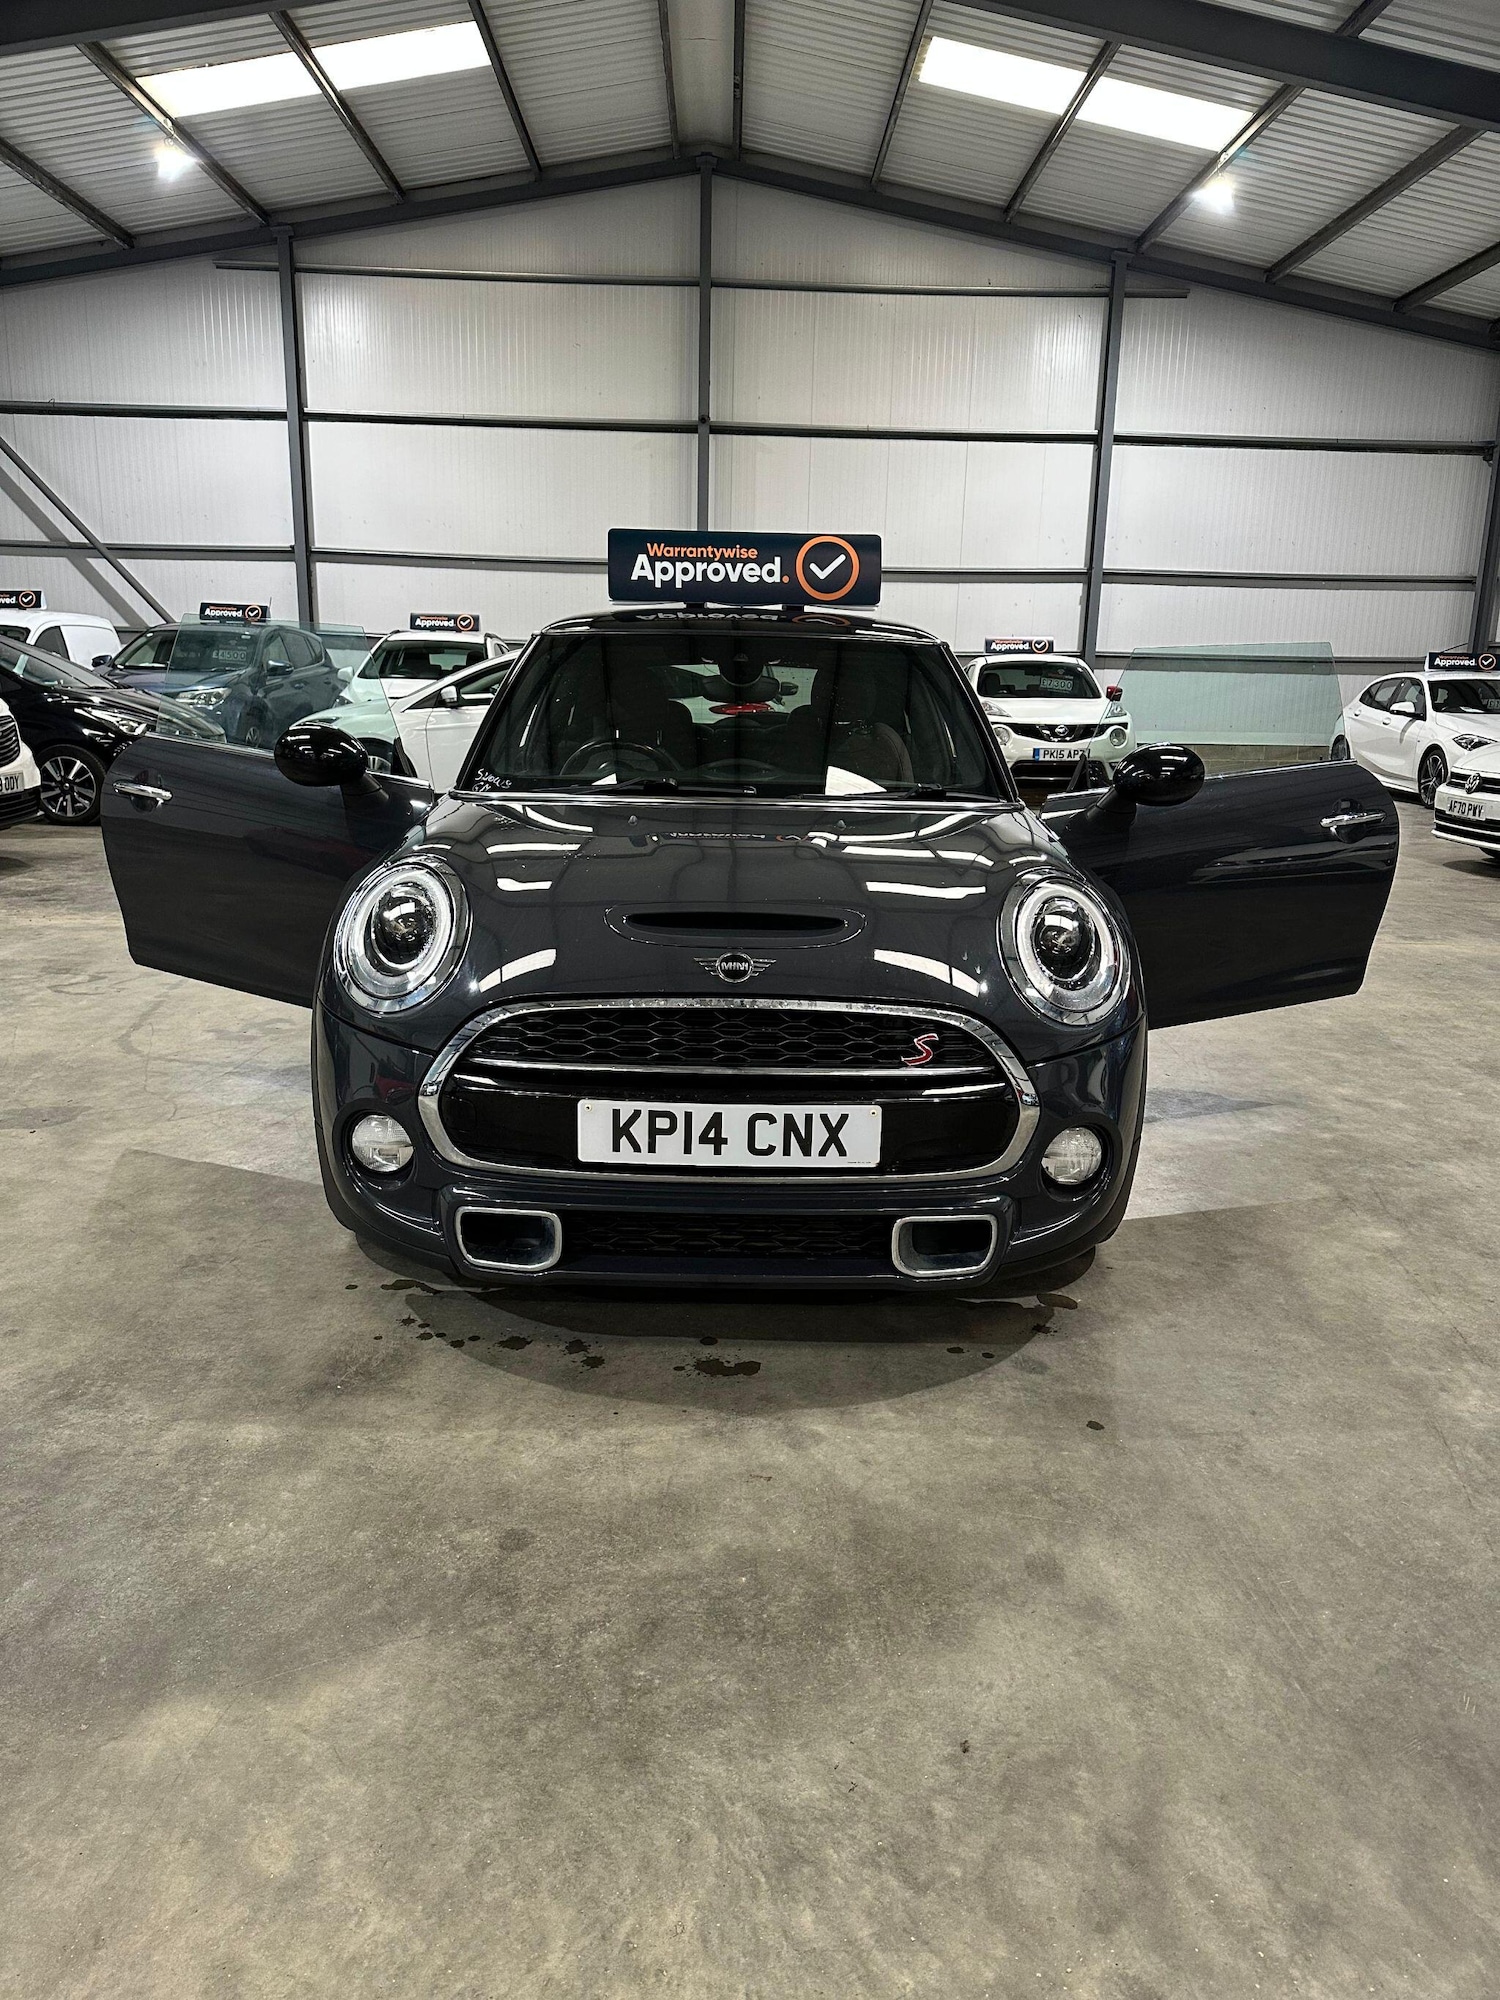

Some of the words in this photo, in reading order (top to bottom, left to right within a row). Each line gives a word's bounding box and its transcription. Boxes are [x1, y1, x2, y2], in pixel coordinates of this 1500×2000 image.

[646, 543, 758, 561] Warrantywise
[630, 553, 790, 589] Approved.
[1043, 749, 1065, 759] PK15
[721, 961, 749, 971] MINI
[901, 1033, 939, 1066] S
[612, 1109, 728, 1157] KP14
[747, 1112, 849, 1157] CNX
